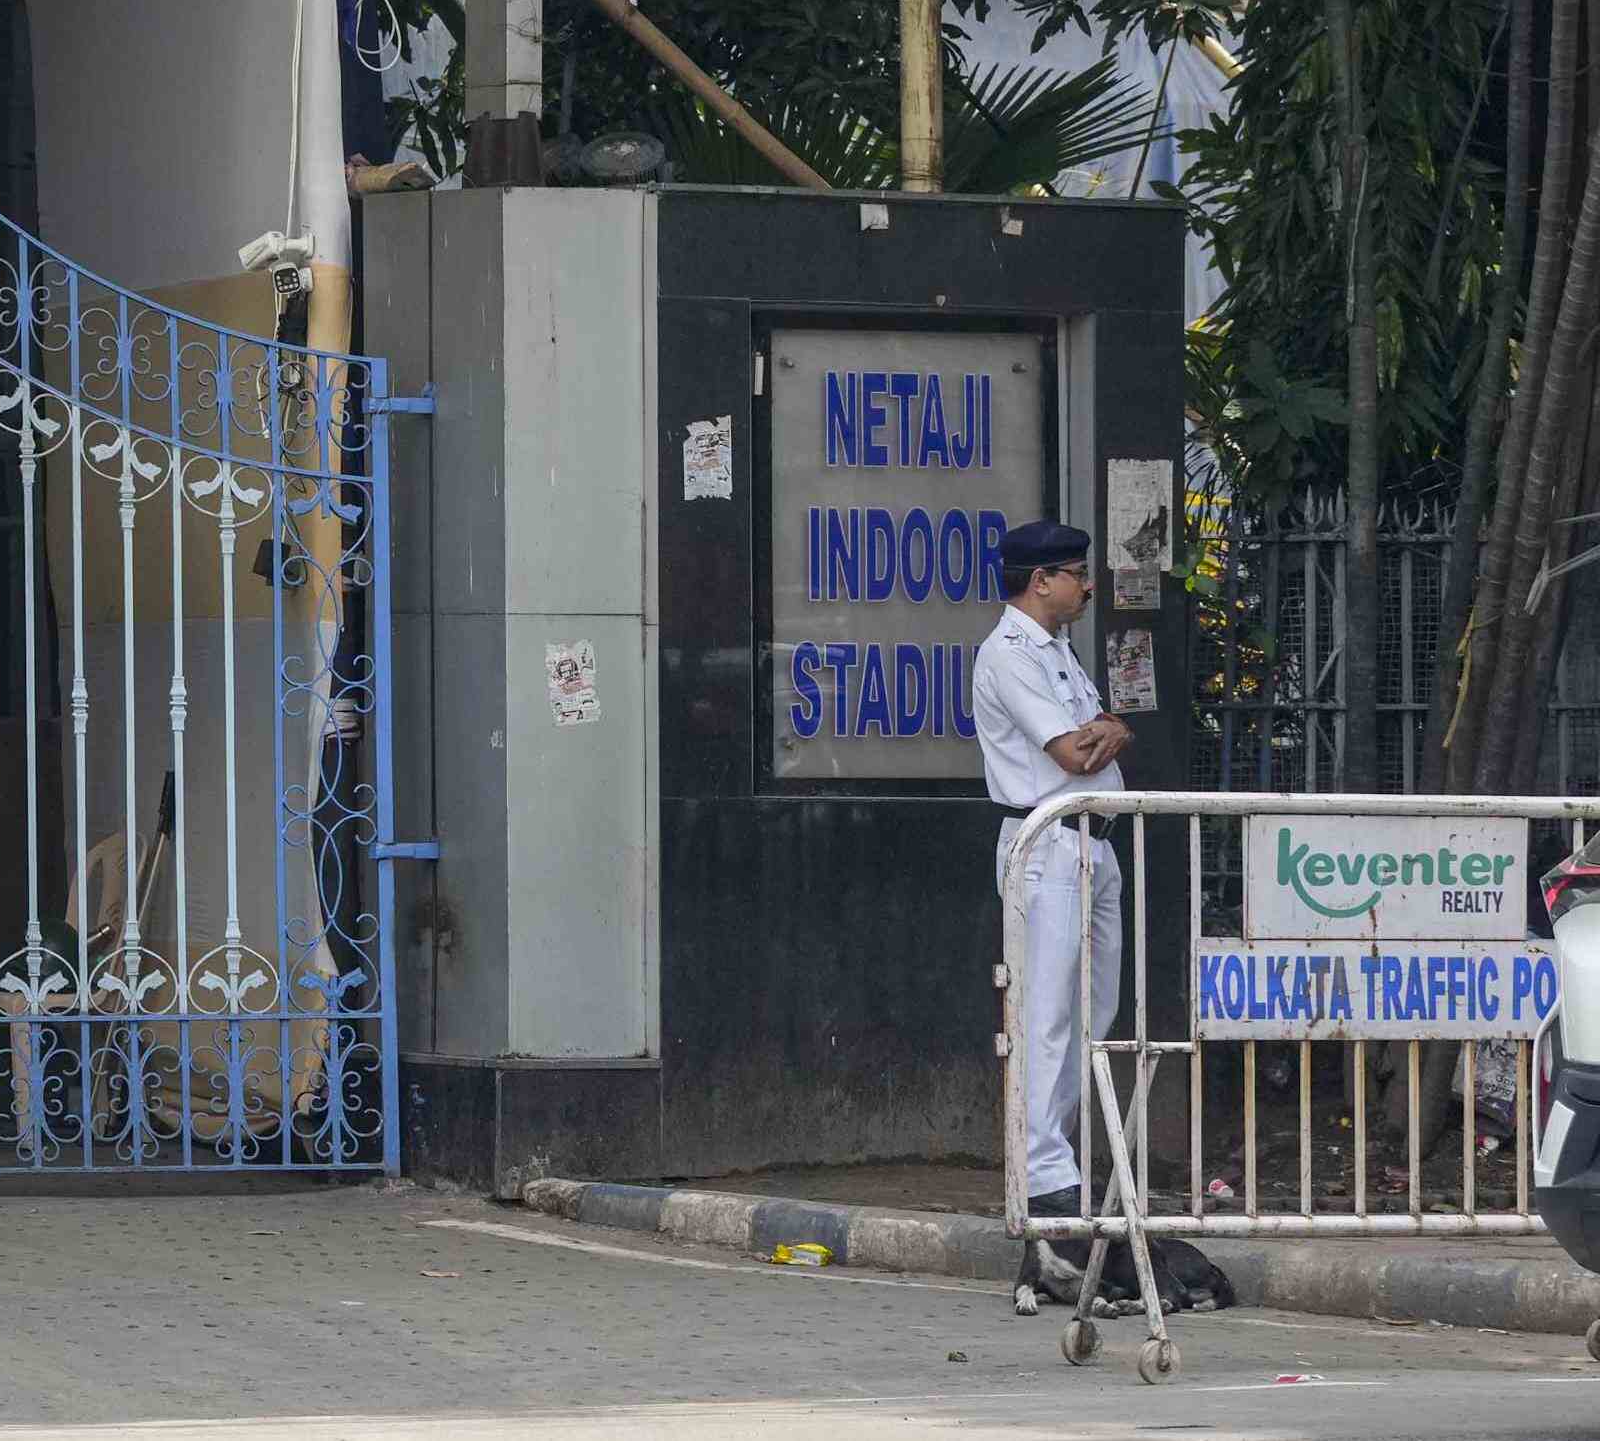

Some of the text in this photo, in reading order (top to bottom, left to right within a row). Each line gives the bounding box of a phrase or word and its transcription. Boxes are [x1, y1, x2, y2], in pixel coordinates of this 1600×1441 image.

[825, 371, 992, 469] NETAJI
[808, 506, 1008, 603] INDOOR
[790, 641, 978, 739] STADIU
[1442, 890, 1504, 914] REALTY
[1200, 953, 1557, 1023] KOLKATA TRAFFIC PO
